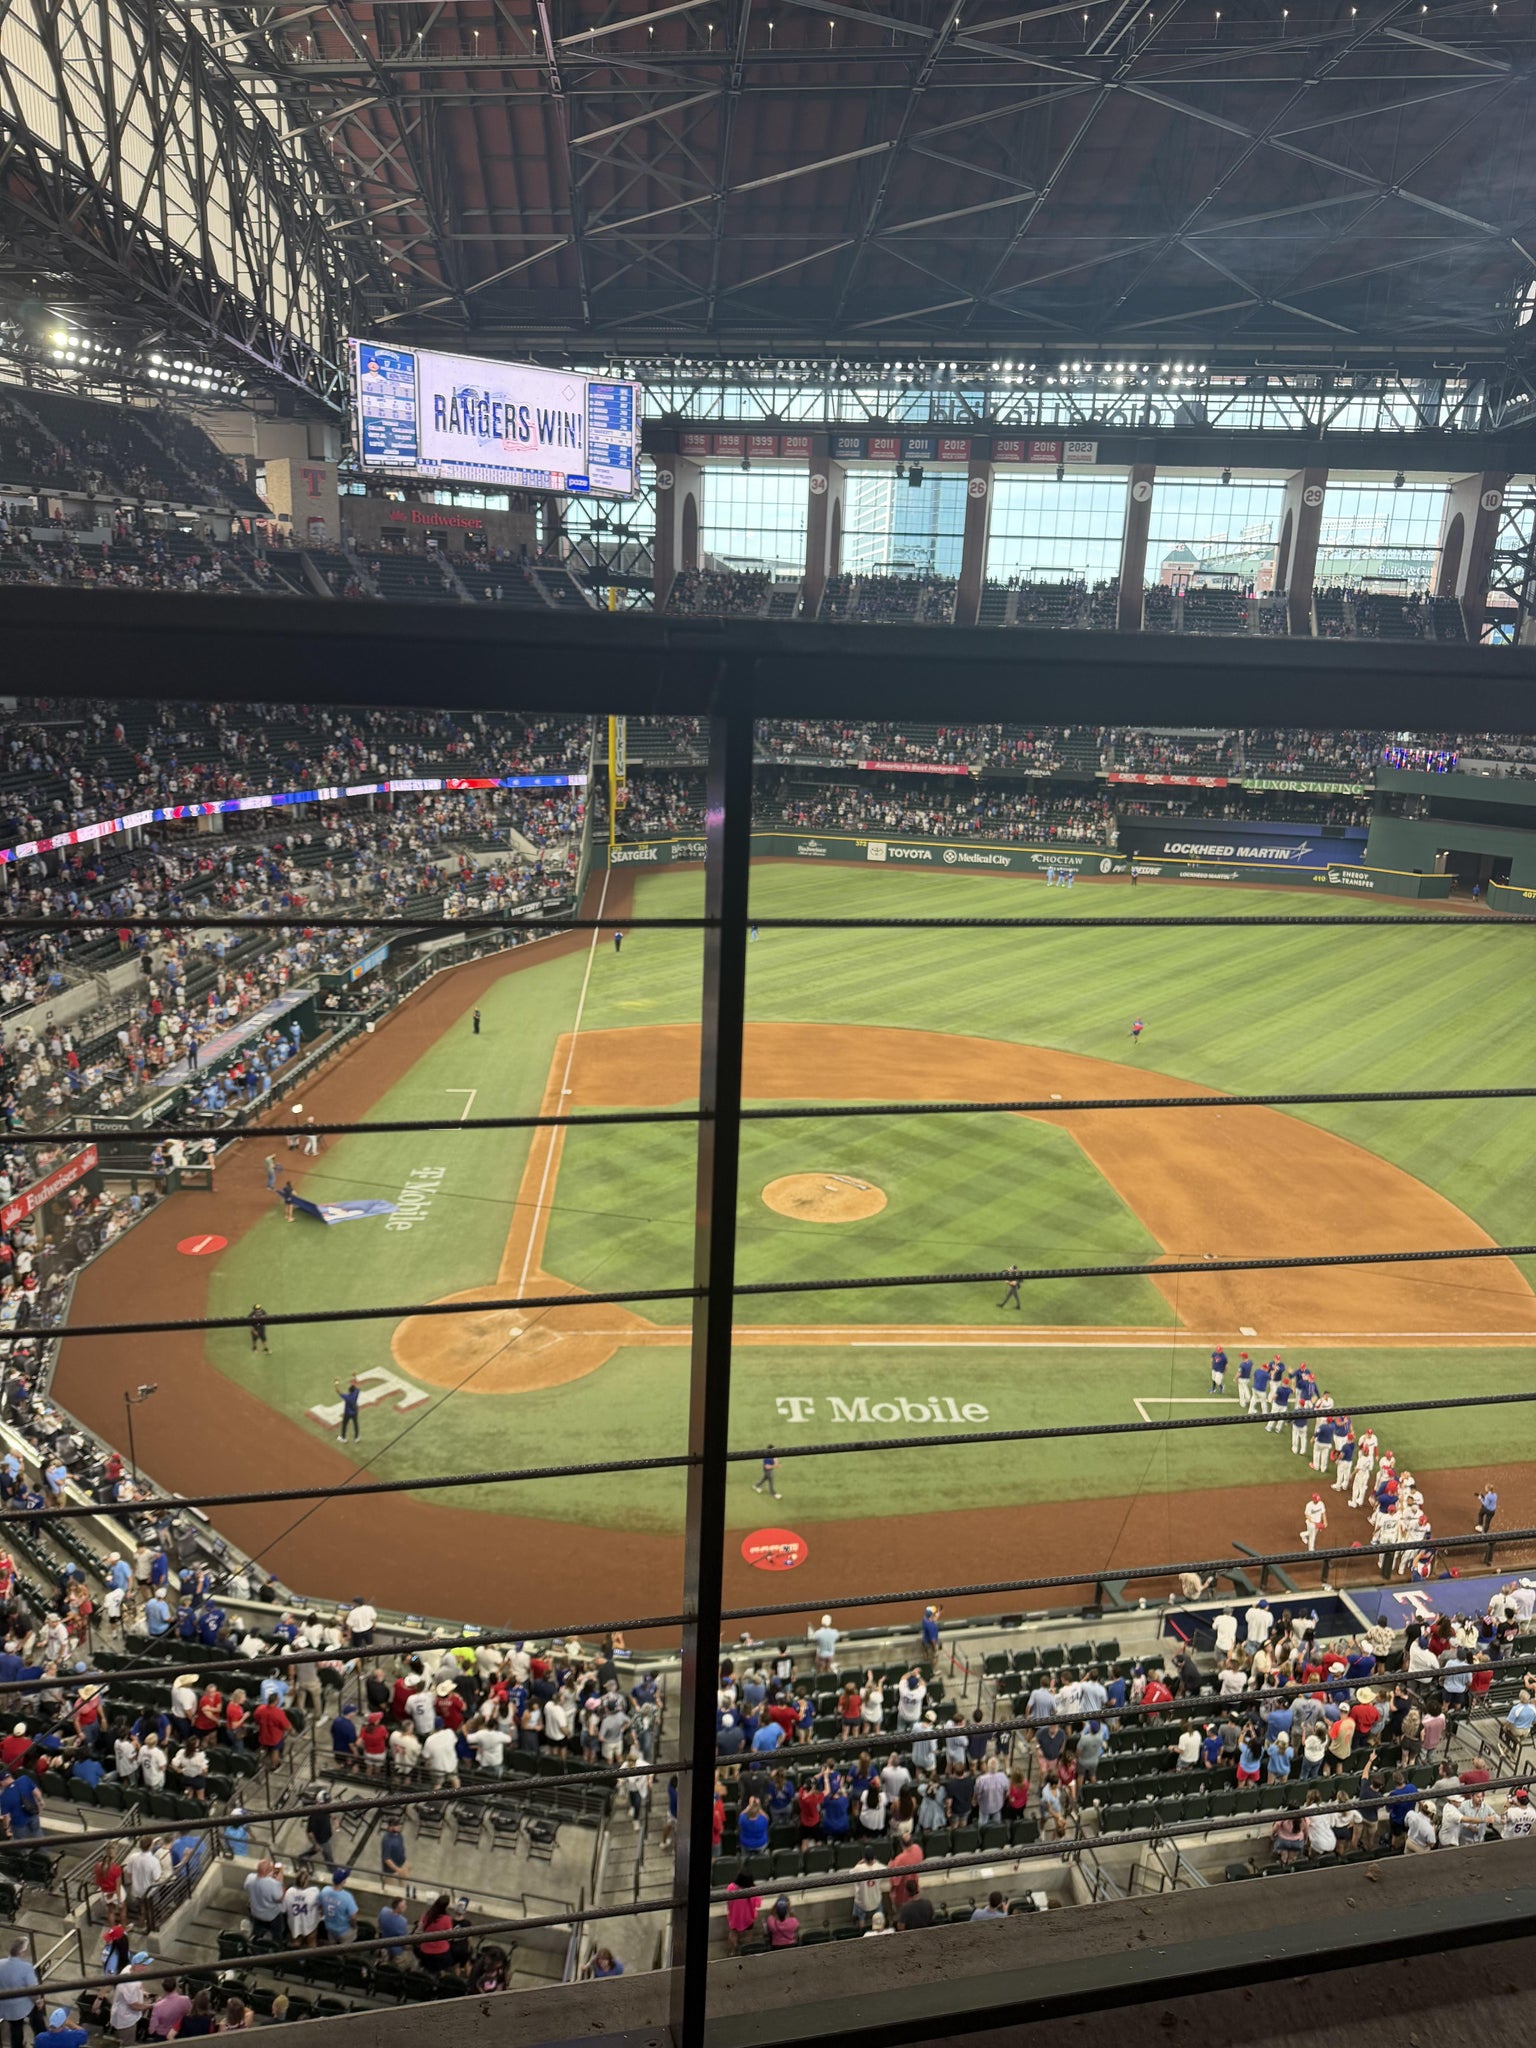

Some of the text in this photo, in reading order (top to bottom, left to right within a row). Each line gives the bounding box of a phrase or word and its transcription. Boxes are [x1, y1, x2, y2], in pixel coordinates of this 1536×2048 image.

[434, 391, 531, 443] RANGERS
[536, 406, 583, 450] WIN!
[719, 436, 740, 446] 1998
[752, 436, 773, 447] 1999
[786, 437, 808, 447] 2010
[838, 438, 860, 448] 2010
[874, 439, 895, 449] 2011
[908, 440, 929, 450] 2011
[944, 440, 966, 450] 2012
[997, 441, 1020, 451] 2015
[1033, 442, 1056, 452] 2016
[1068, 442, 1093, 453] 2023
[657, 474, 672, 486] 42
[811, 479, 825, 490] 34
[970, 482, 984, 494] 26
[1138, 485, 1147, 498] 7
[1306, 490, 1322, 502] 29
[1485, 494, 1499, 507] 10
[411, 510, 482, 529] Budweiser
[875, 762, 959, 773] America's Best Network
[1254, 779, 1362, 795] LUXOR STAFFING
[611, 848, 657, 863] SEATGEEK
[888, 847, 932, 860] TOYOTA
[1163, 842, 1291, 860] LOCKHEED MARTIN
[958, 852, 1011, 867] Medical City
[1036, 854, 1084, 865] CHOCTAW
[1179, 871, 1230, 880] LOCKHEED MARTIN
[1312, 875, 1326, 883] 410
[1342, 870, 1369, 880] ENERGY
[1341, 877, 1375, 889] TRANSFER
[510, 902, 540, 916] VICTORY
[94, 1123, 131, 1131] TOYOTA
[25, 1167, 79, 1212] Budweiser
[775, 1396, 990, 1423] T Mobile
[415, 1704, 424, 1716] 5
[1514, 1823, 1532, 1834] 53
[292, 1903, 308, 1916] 34
